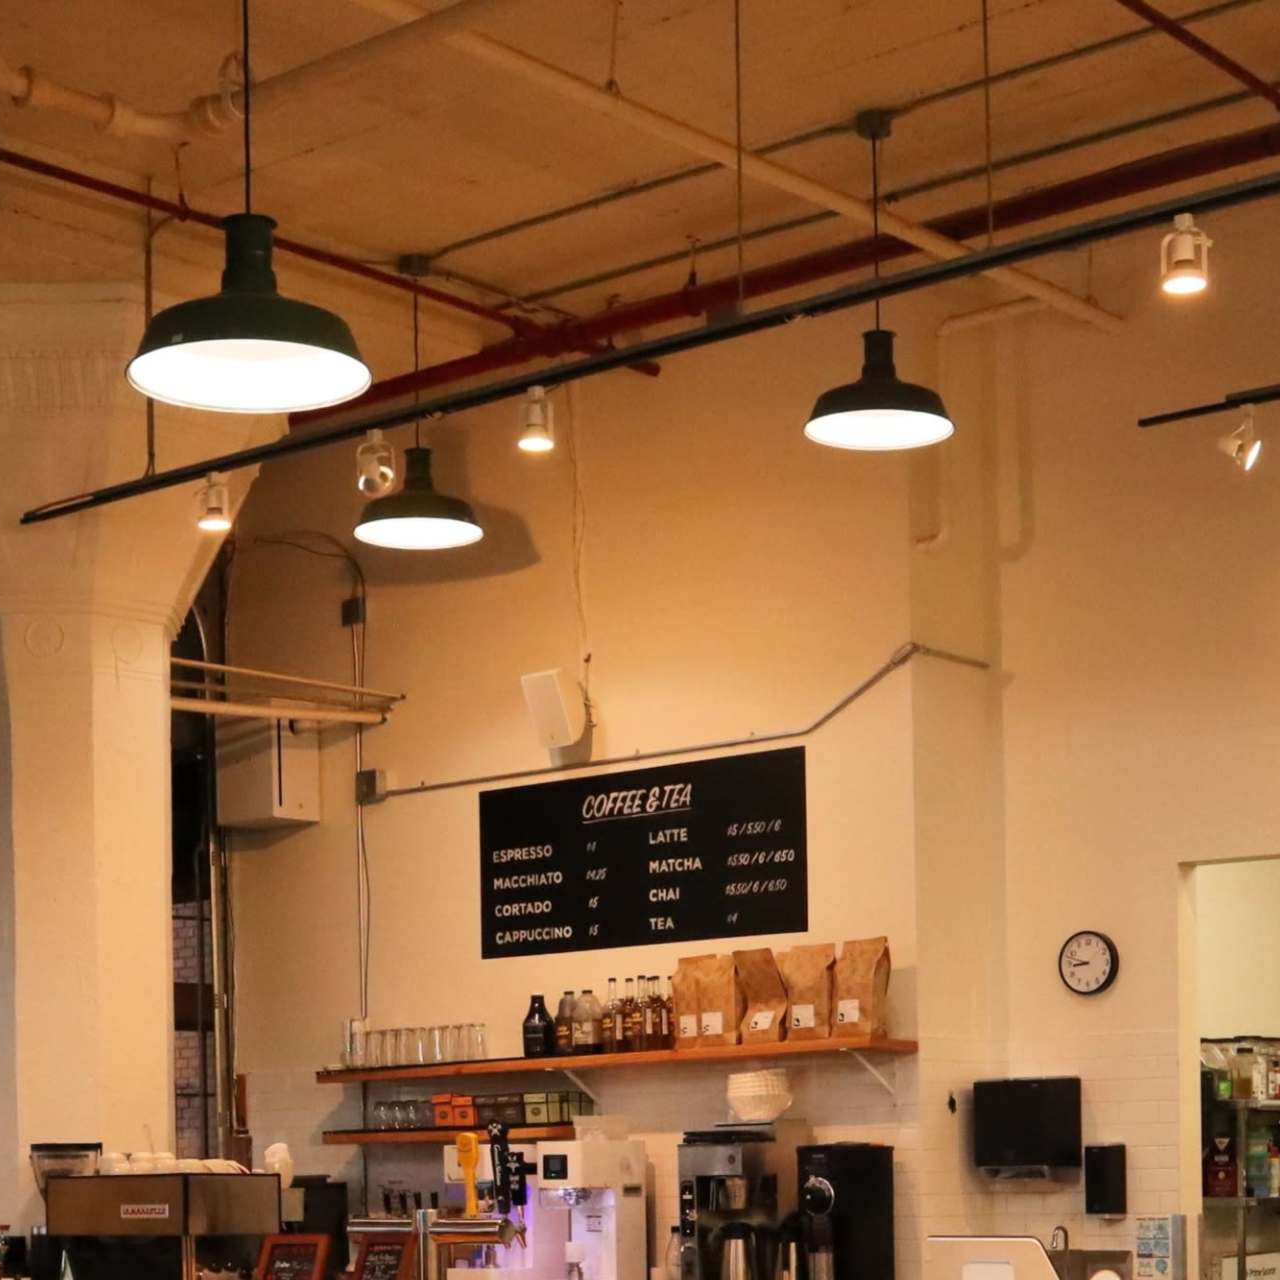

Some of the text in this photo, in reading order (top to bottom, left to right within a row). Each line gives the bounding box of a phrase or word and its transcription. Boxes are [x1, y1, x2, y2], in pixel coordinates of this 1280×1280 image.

[582, 783, 693, 819] COFFEE & TEA
[648, 828, 689, 845] LATTE
[493, 844, 553, 863] ESPRESSO
[649, 857, 703, 874] MATCHA
[493, 871, 563, 890] MACCHIATO
[649, 887, 681, 902] CHAI
[494, 900, 552, 918] CORTADO
[649, 917, 675, 931] TEA
[496, 926, 573, 945] CAPPUCCINO
